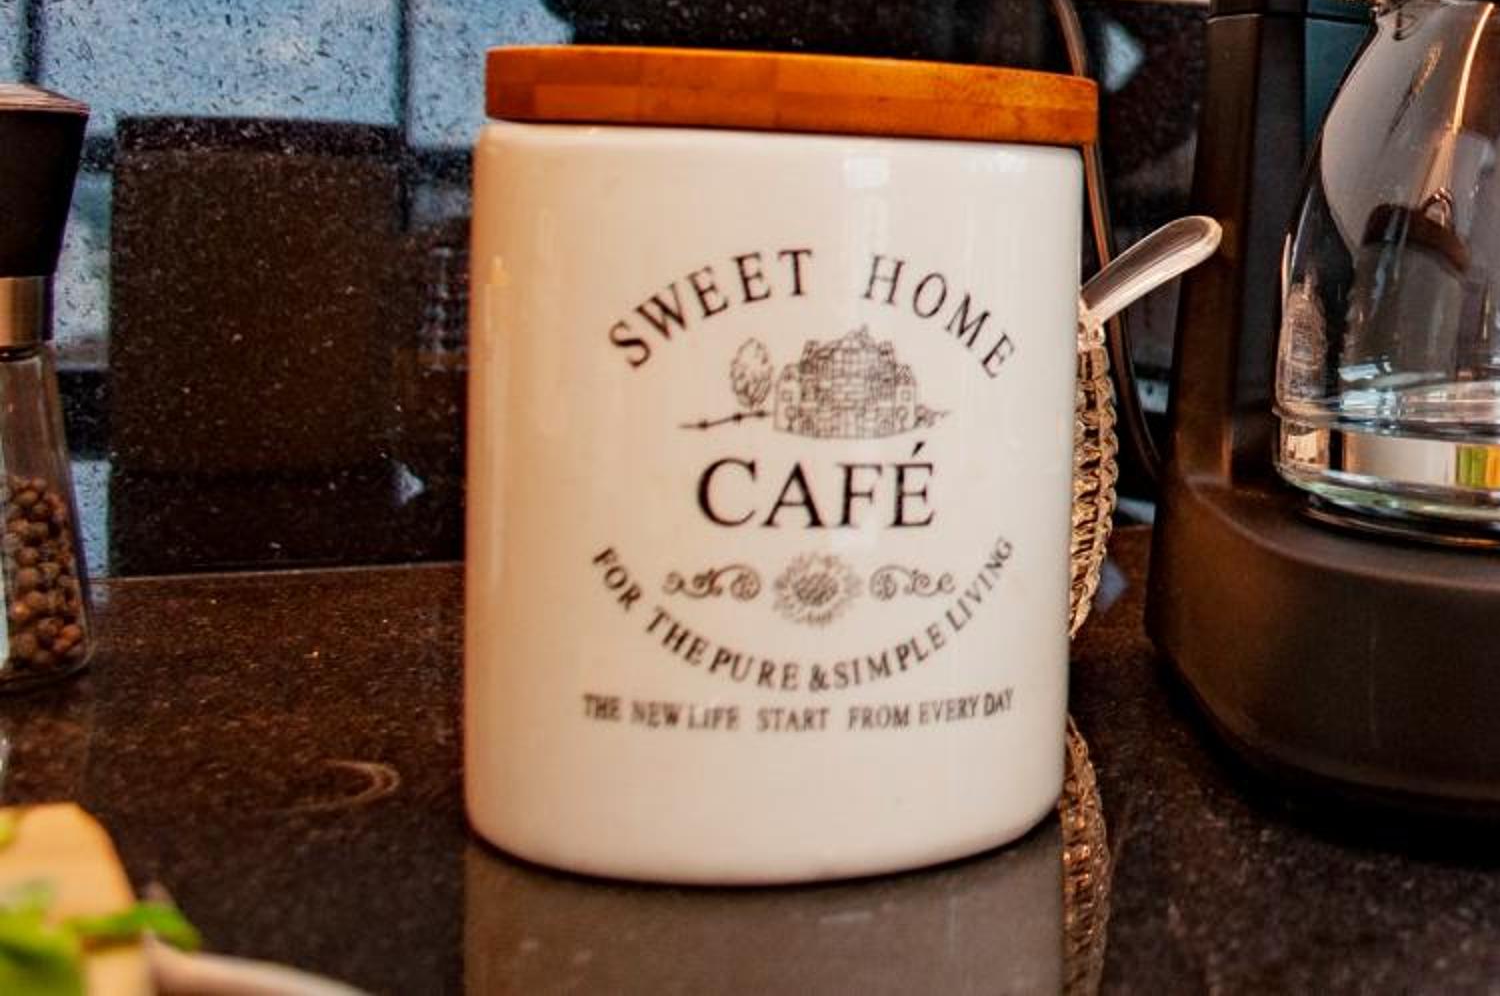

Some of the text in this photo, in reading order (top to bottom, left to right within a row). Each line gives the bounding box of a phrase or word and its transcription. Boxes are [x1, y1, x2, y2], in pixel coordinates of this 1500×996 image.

[608, 248, 1016, 379] SWEET HOME
[696, 442, 935, 529] CAFÉ
[592, 546, 643, 613] FOR
[646, 605, 708, 667] THE
[708, 646, 799, 692] PURE
[832, 625, 948, 690] SIMPLE
[946, 536, 1015, 632] LIVING
[583, 693, 621, 722] THE
[630, 699, 682, 728] NEW
[687, 703, 739, 731] LIFE
[756, 706, 831, 732] START
[847, 703, 910, 731] FROM
